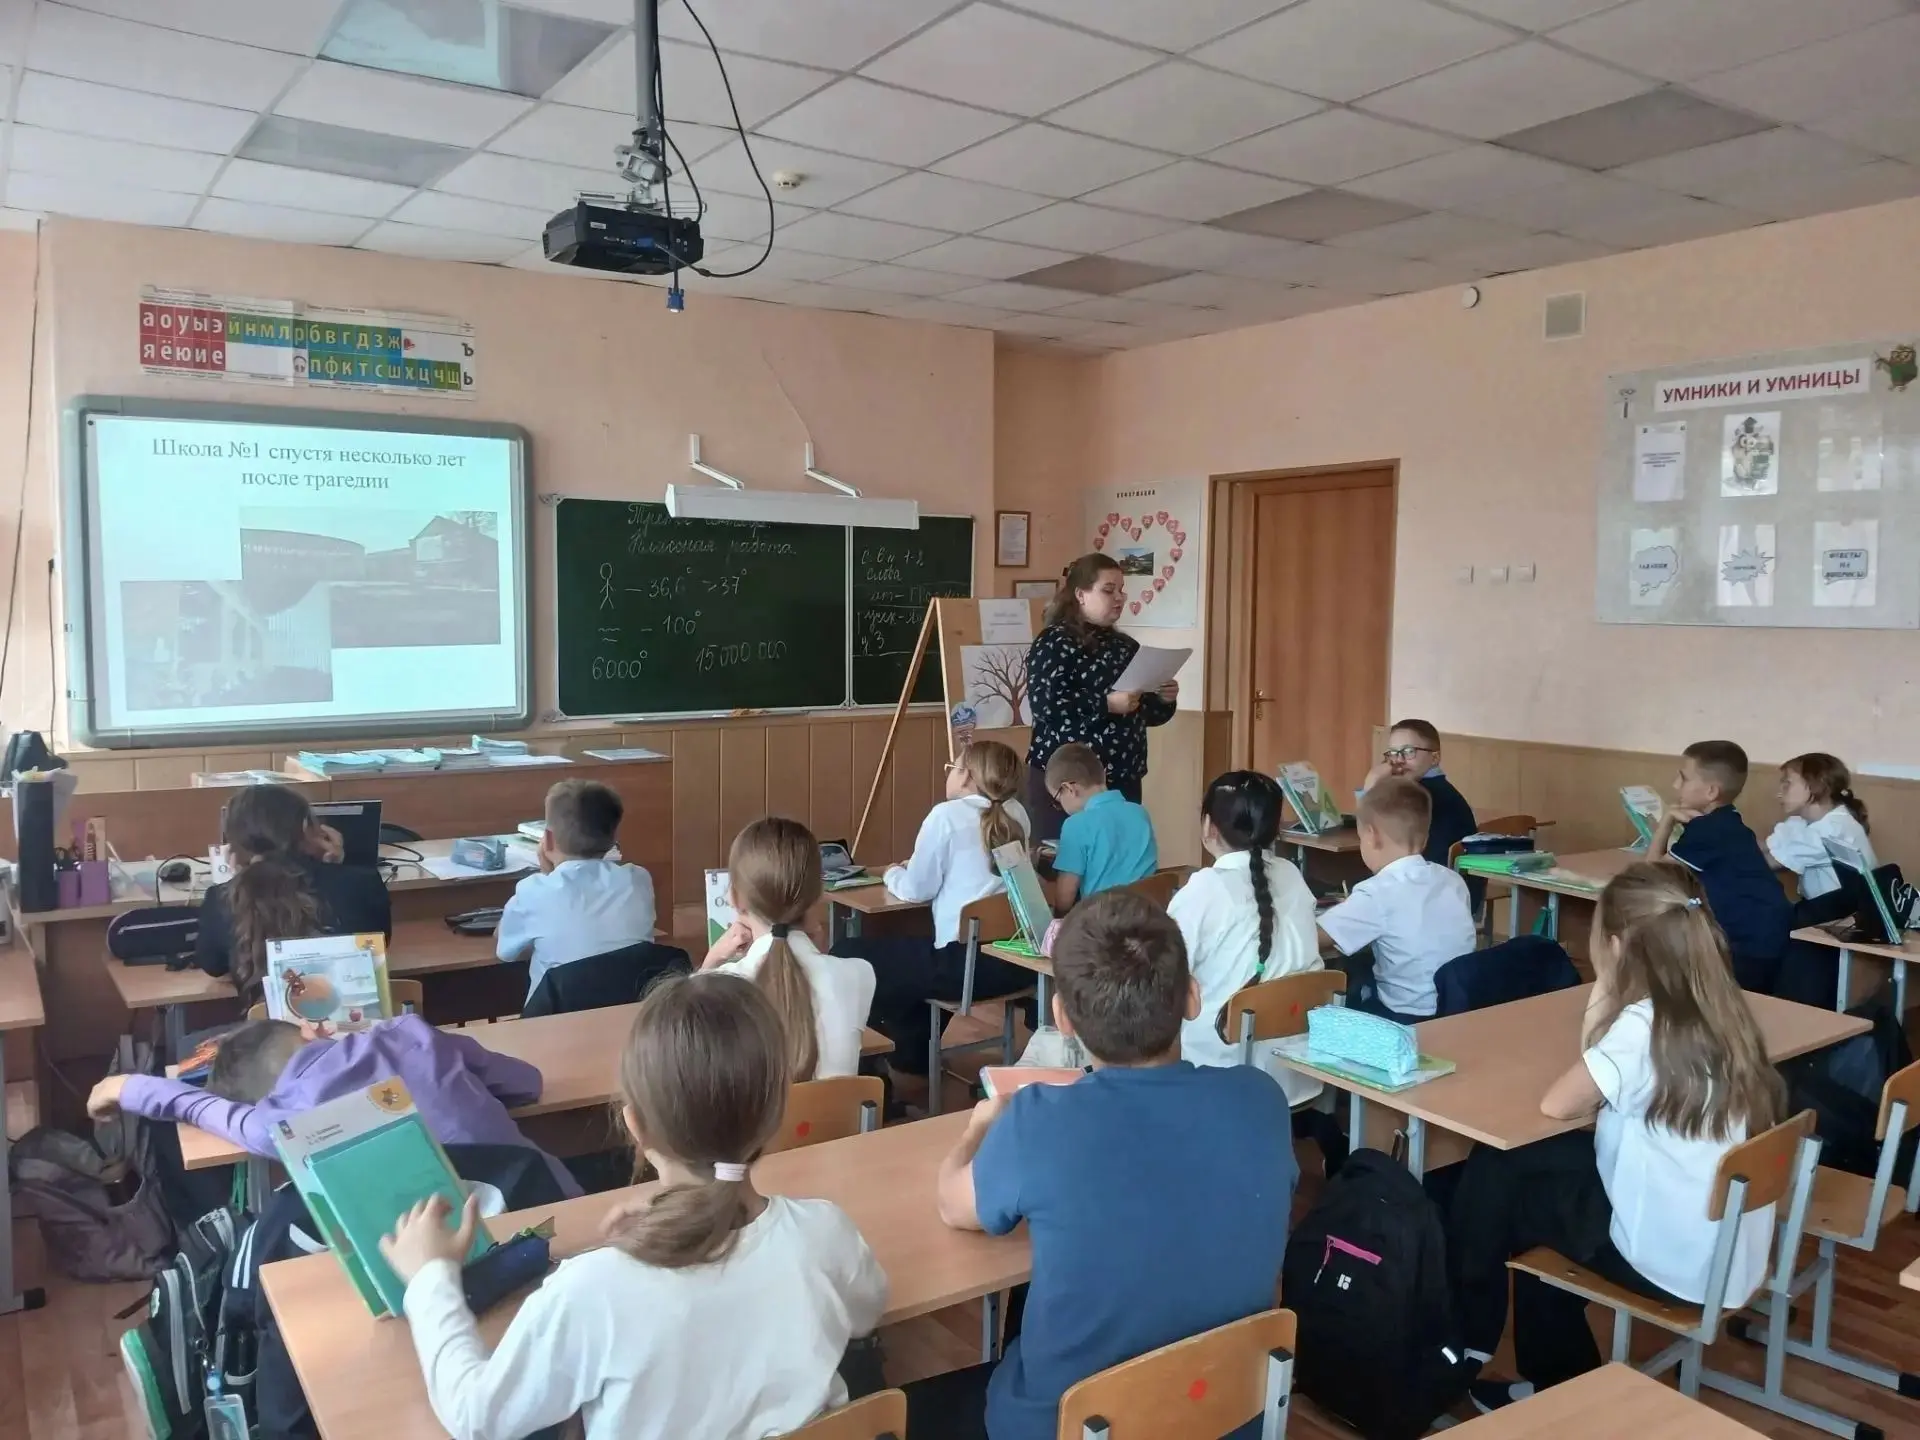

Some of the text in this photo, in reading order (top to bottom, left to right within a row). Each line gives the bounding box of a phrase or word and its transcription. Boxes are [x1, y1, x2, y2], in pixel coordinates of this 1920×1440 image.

[1663, 368, 1860, 403] УМНИКИ И УМНИЦЫ
[152, 438, 466, 467] Школа №1 спустя несколько лет
[241, 472, 389, 491] после трагедии
